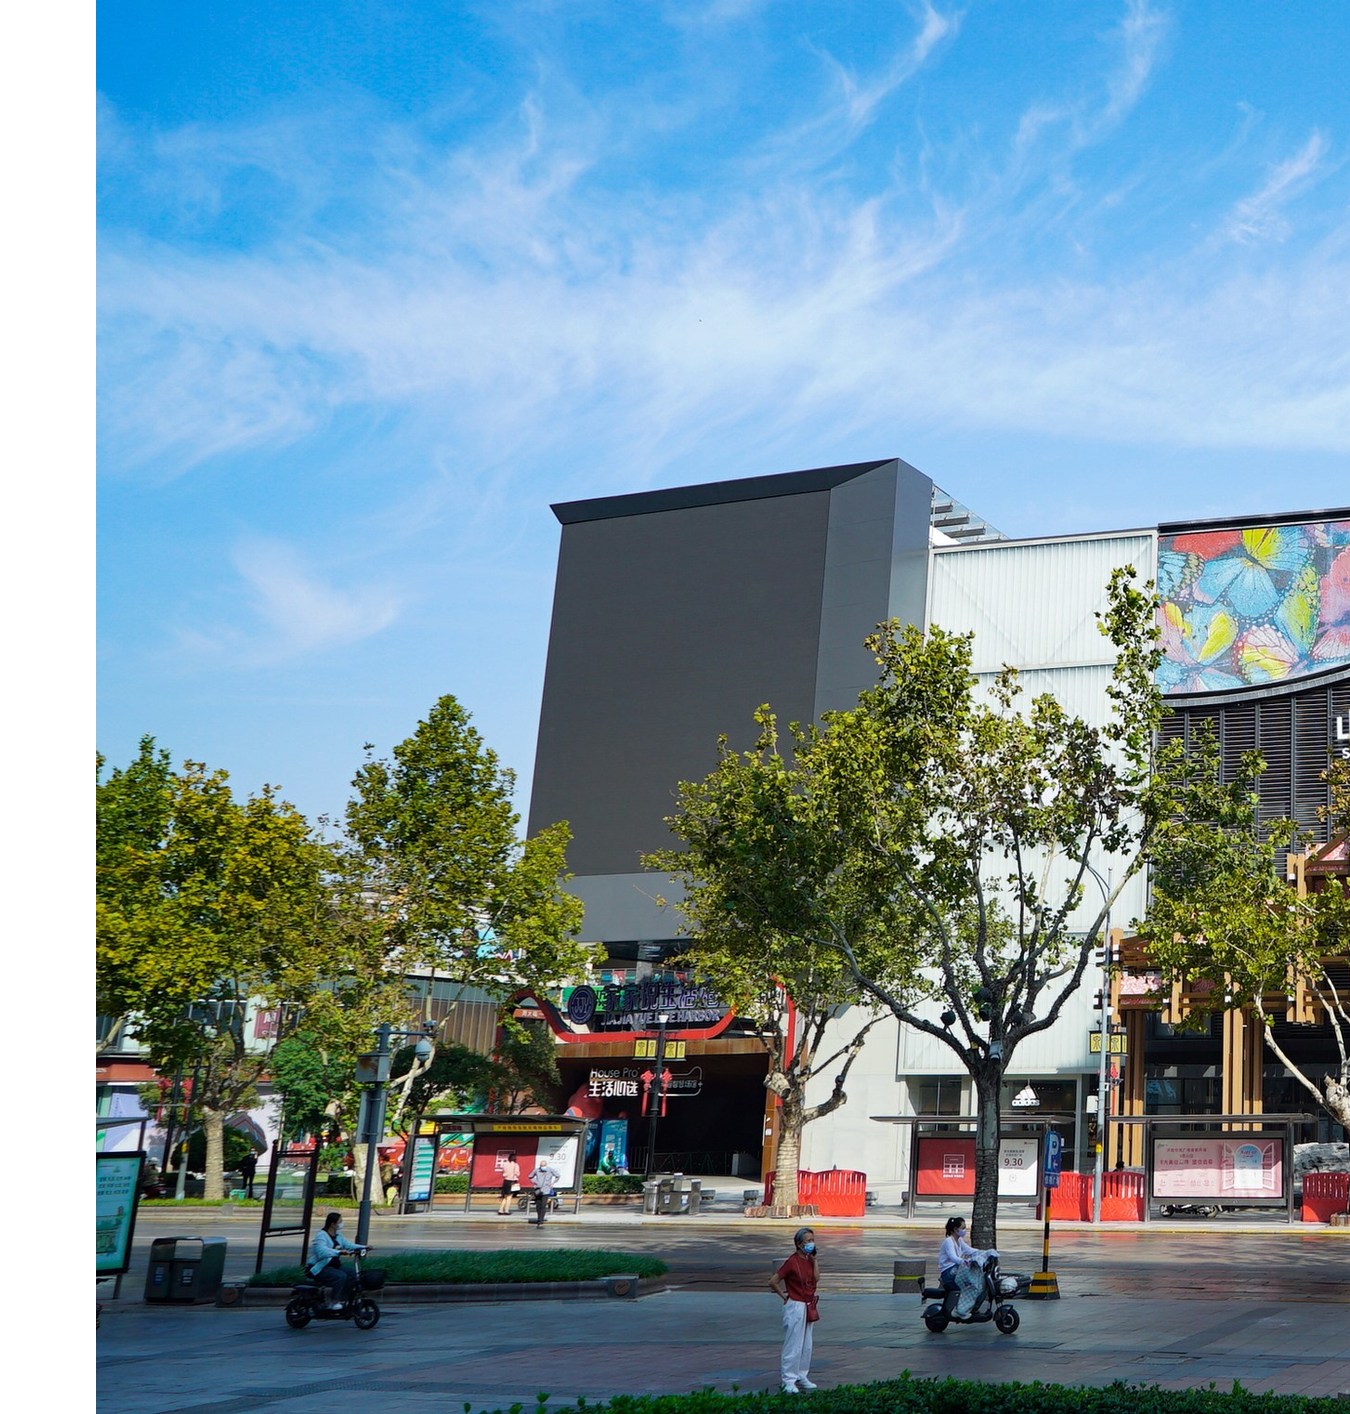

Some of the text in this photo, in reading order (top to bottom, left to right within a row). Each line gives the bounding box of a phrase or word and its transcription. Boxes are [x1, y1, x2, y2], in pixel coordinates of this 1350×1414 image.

[590, 1067, 638, 1078] House Pro
[588, 1080, 639, 1098] 生活心选
[1012, 1099, 1040, 1107] adidas
[1047, 1134, 1060, 1169] P
[1004, 1158, 1023, 1167] 9.30
